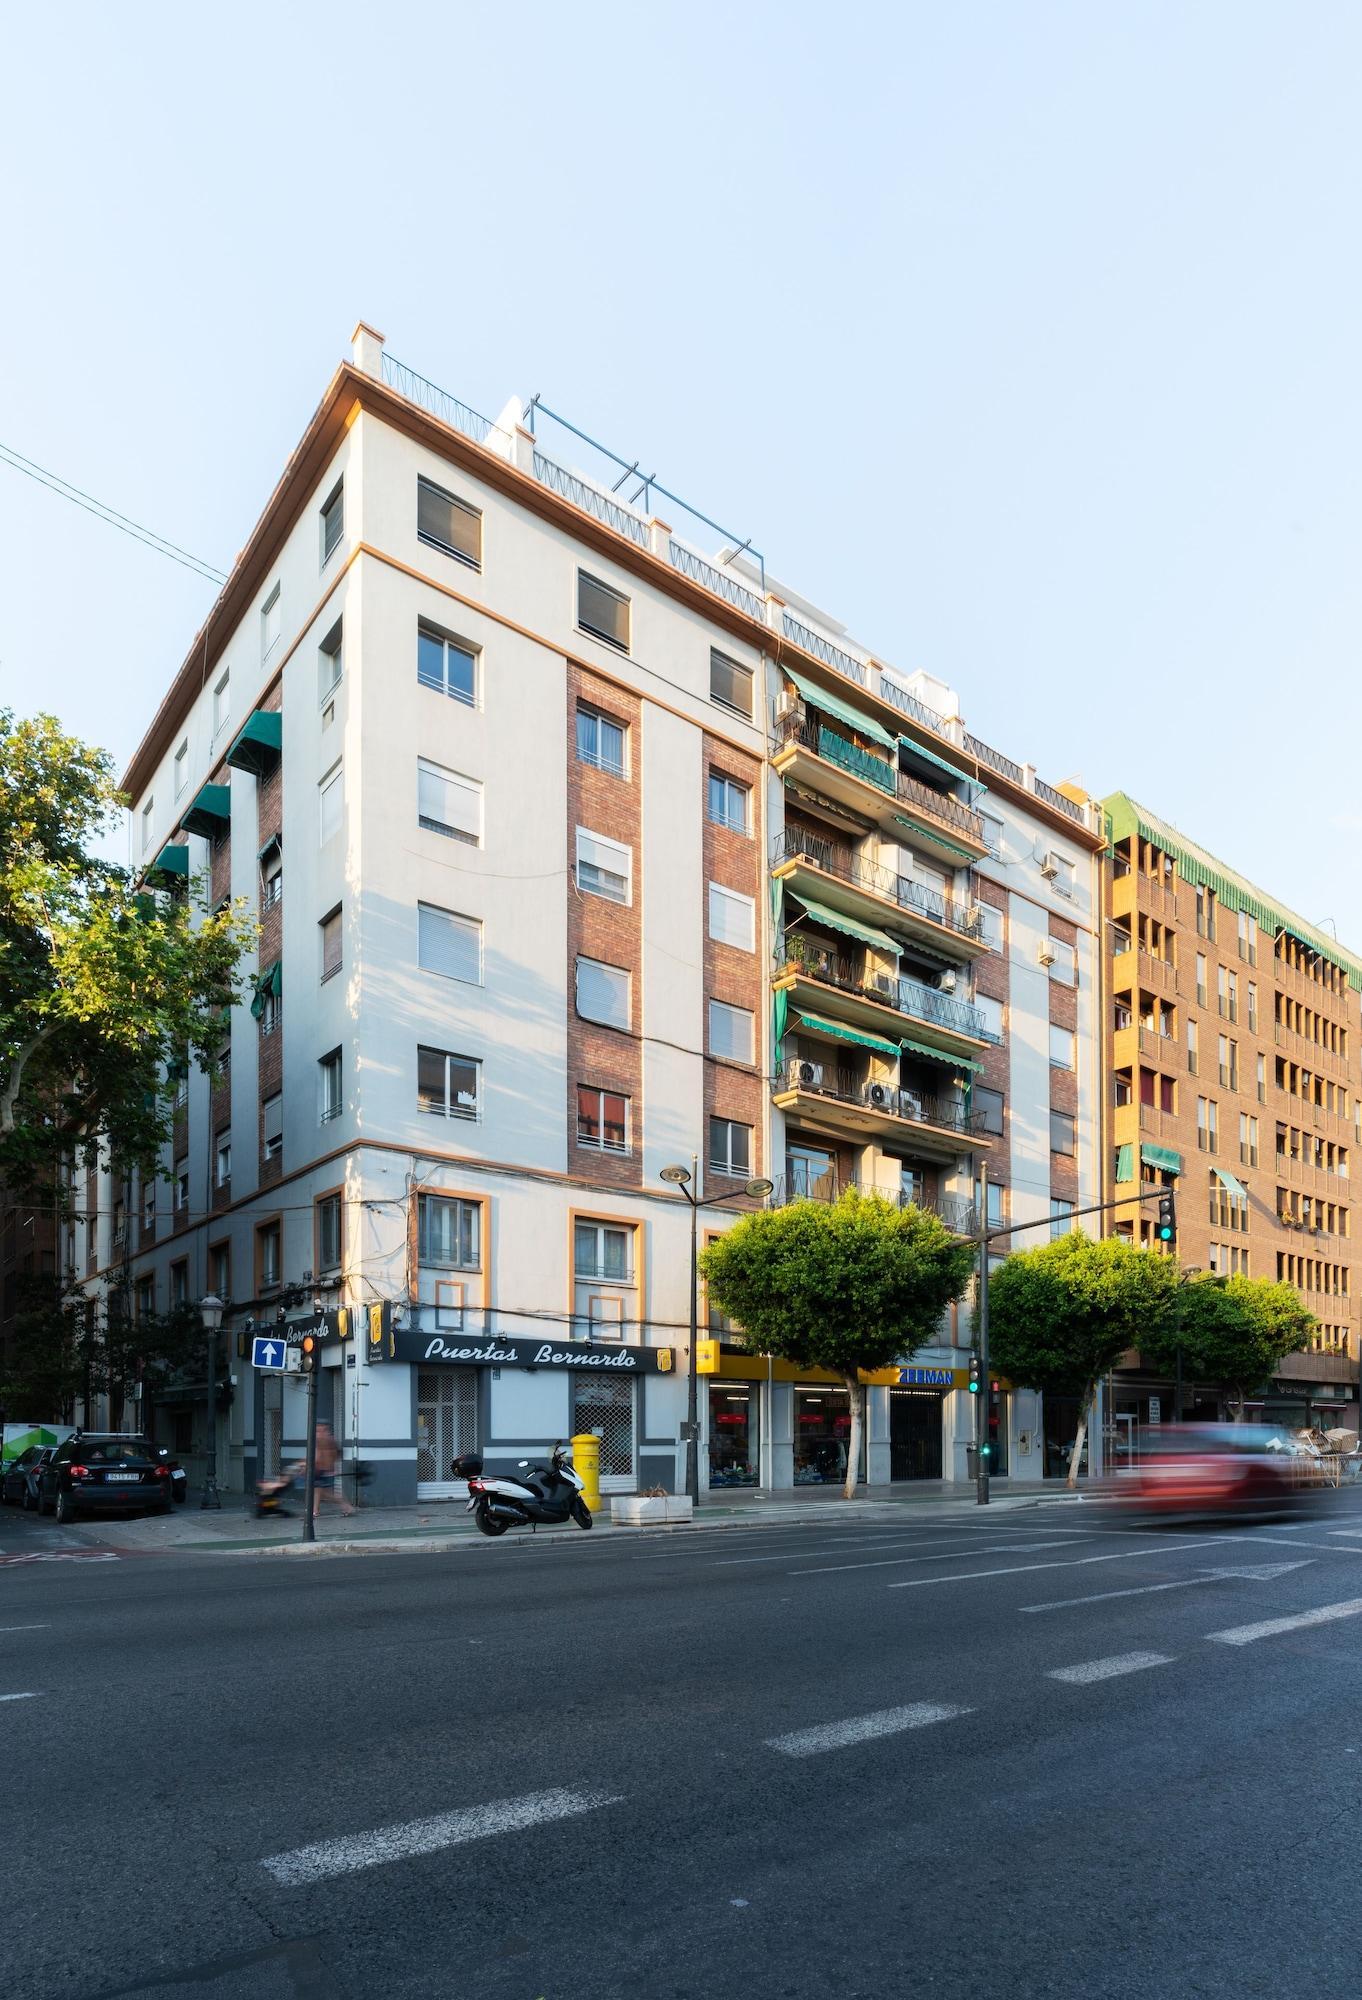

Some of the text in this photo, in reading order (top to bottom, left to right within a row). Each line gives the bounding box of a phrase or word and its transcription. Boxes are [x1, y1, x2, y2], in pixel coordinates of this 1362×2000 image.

[424, 1337, 636, 1367] Puertas Bernardo
[899, 1368, 953, 1385] ZEEMAN
